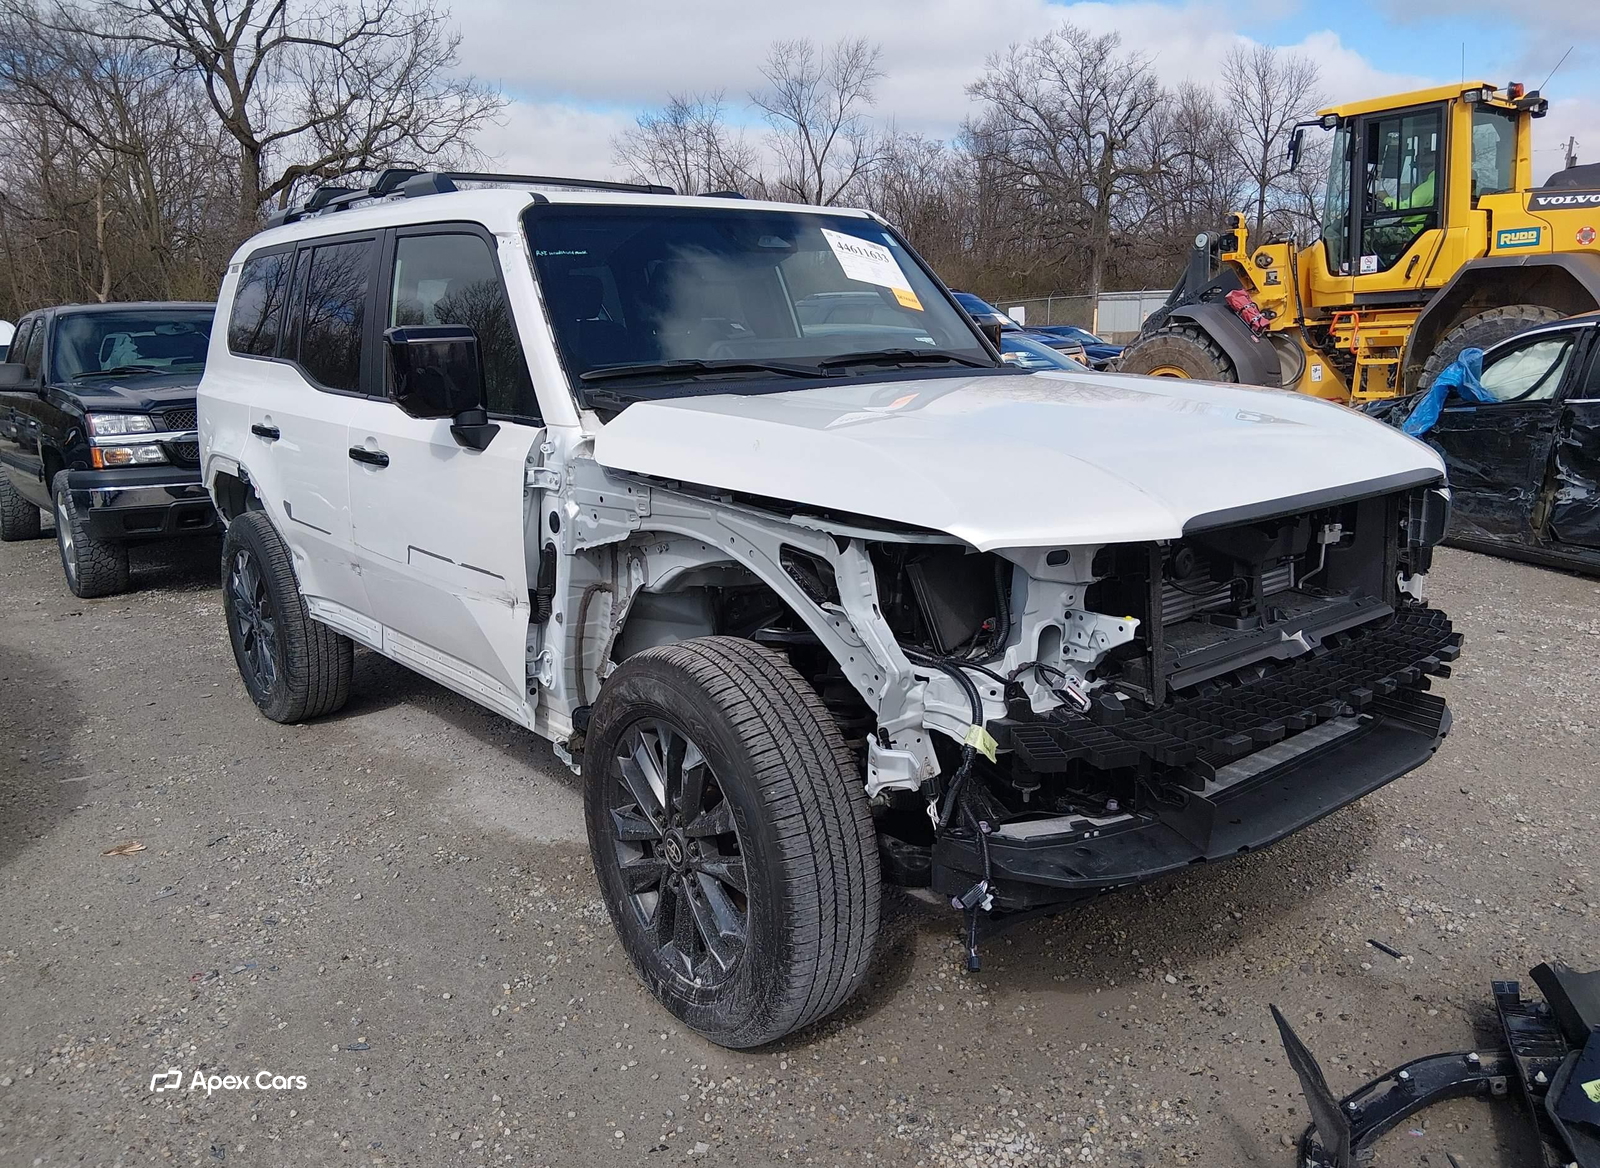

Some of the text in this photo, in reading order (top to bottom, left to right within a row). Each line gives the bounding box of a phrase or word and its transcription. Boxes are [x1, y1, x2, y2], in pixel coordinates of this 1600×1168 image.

[1536, 194, 1600, 205] VOLVO
[1500, 231, 1537, 245] RUDD
[837, 241, 889, 263] 44611633
